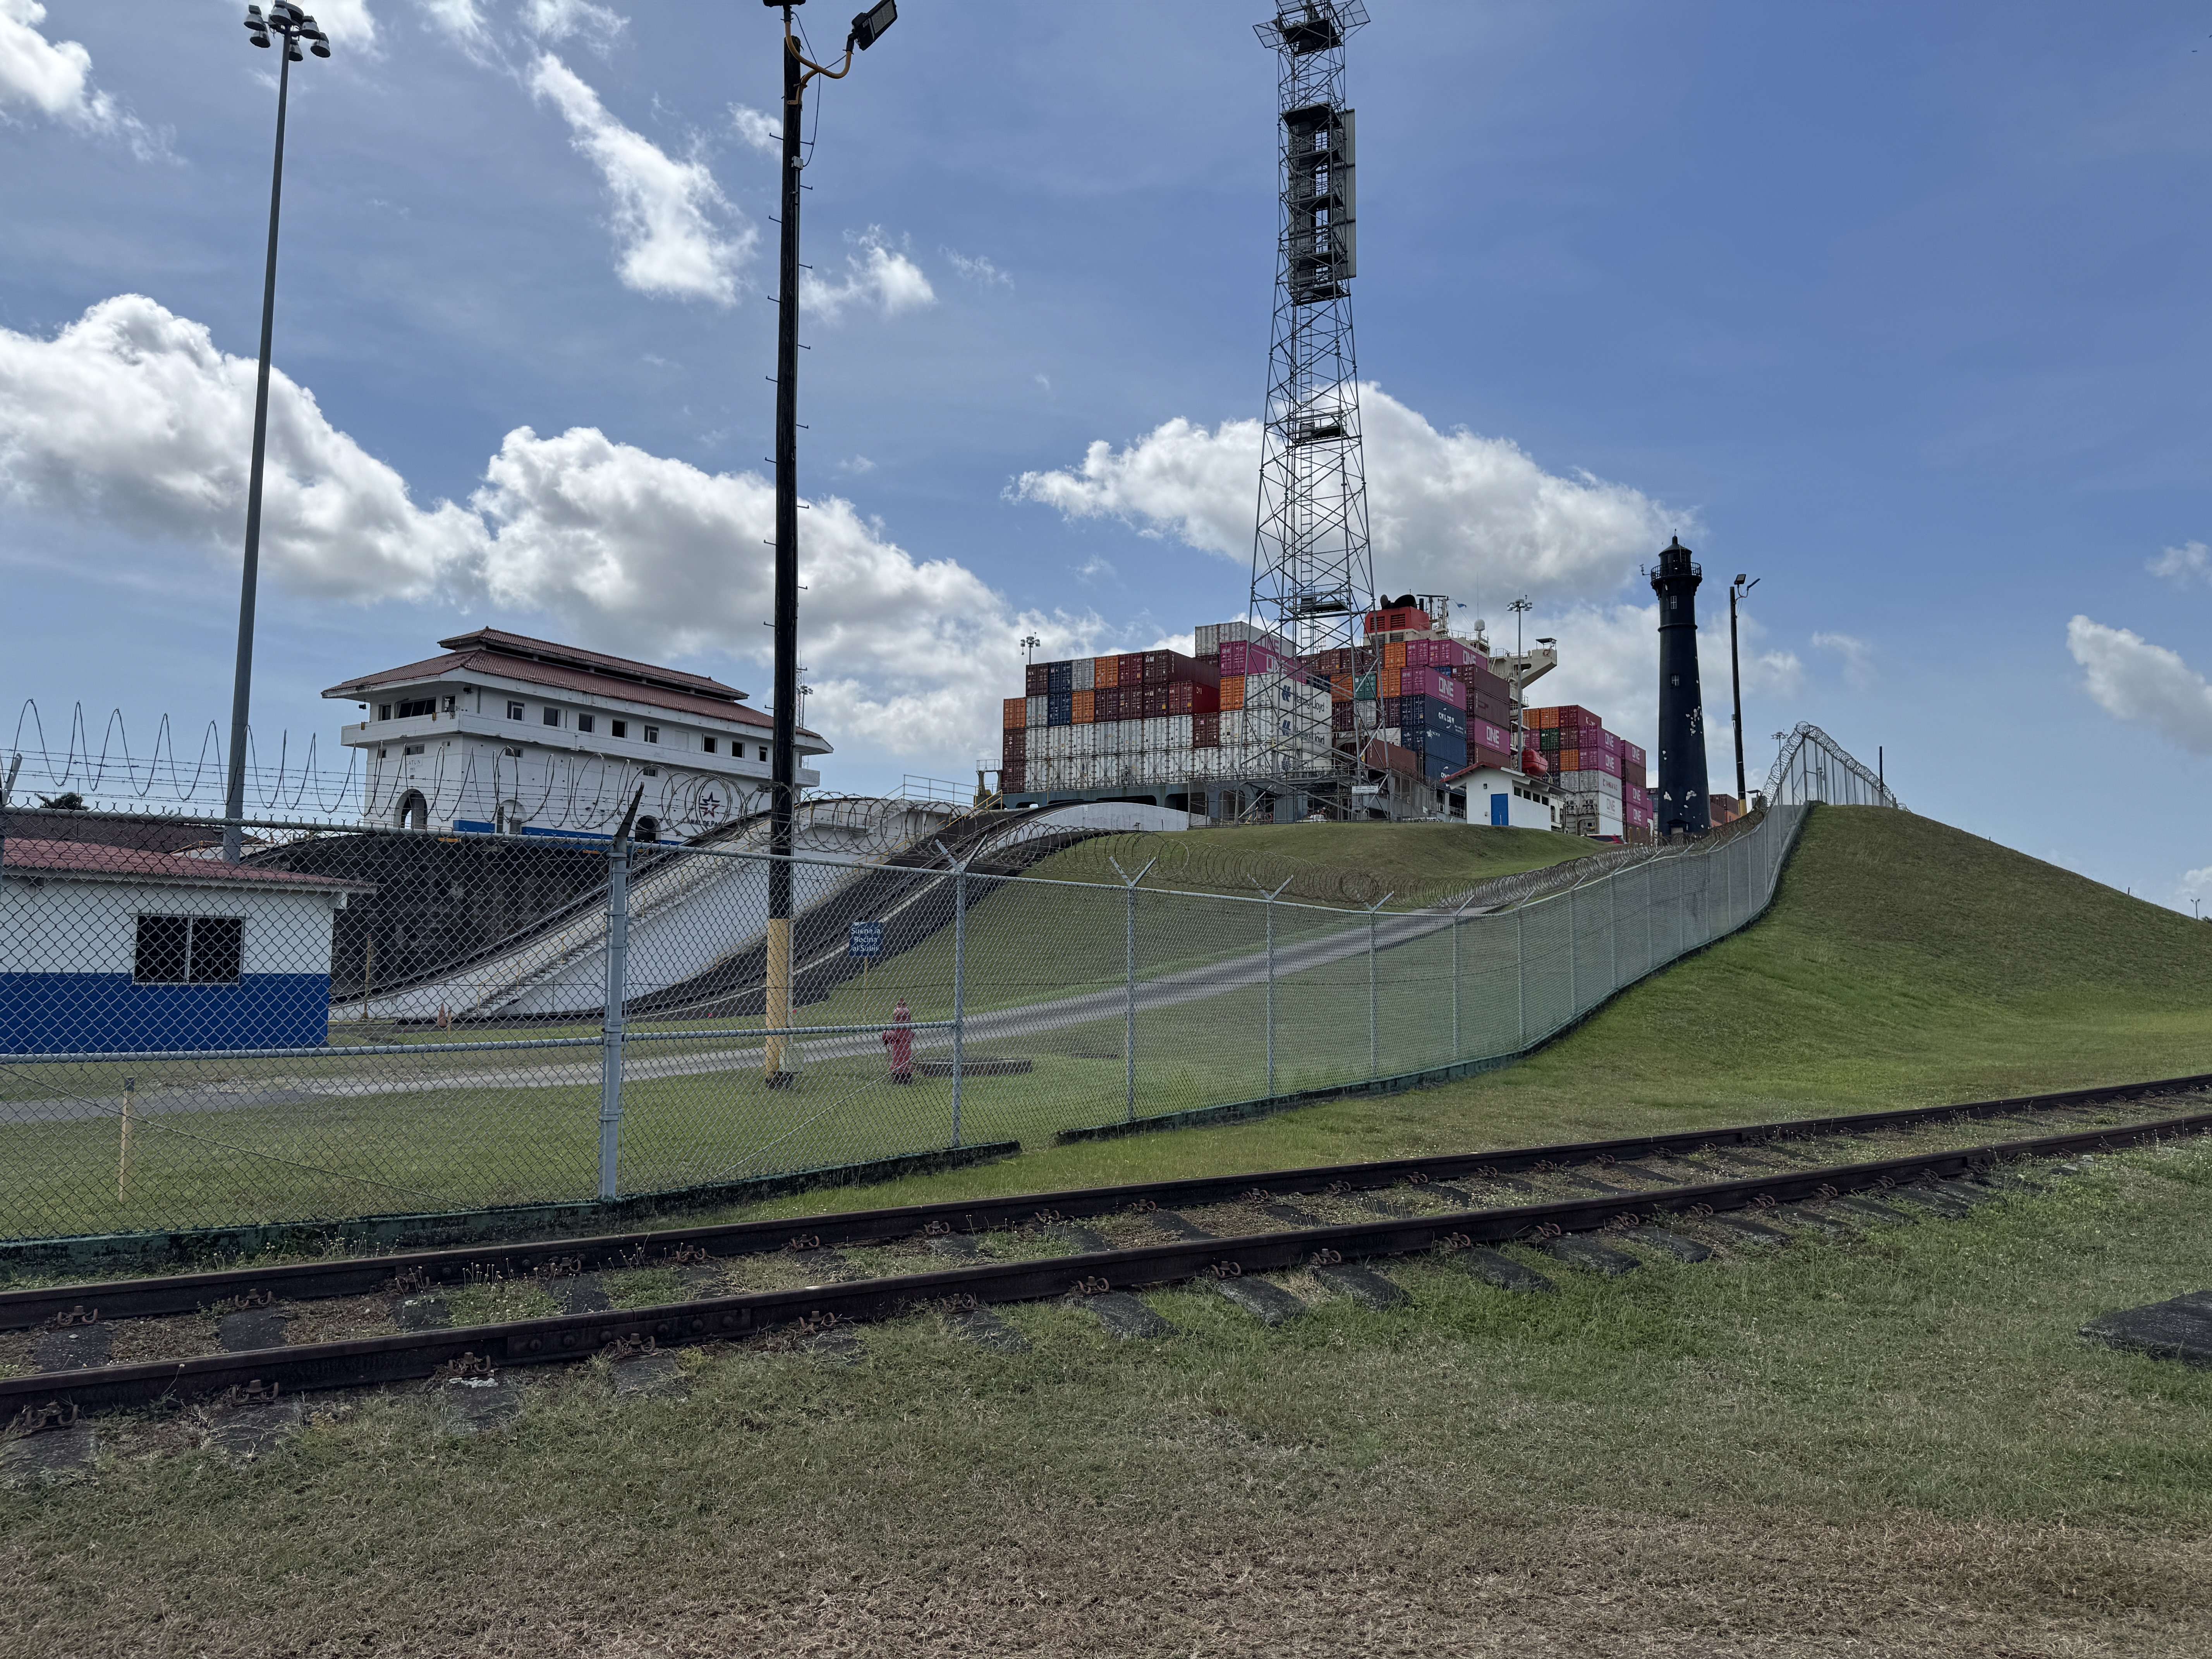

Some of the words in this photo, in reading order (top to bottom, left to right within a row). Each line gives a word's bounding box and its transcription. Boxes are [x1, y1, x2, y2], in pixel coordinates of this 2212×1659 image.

[1260, 634, 1279, 654] ONE
[1266, 654, 1288, 674] ONE
[1463, 649, 1476, 665] ONE
[1439, 676, 1454, 697] ONE
[1438, 712, 1446, 721] CMA
[1486, 725, 1499, 745] ONE
[1605, 733, 1614, 748] ONE
[1606, 754, 1614, 769] ONE
[1632, 747, 1640, 761] ONE
[1633, 788, 1641, 801] ONE
[1607, 798, 1615, 812] ONE
[1633, 809, 1642, 822] ONE
